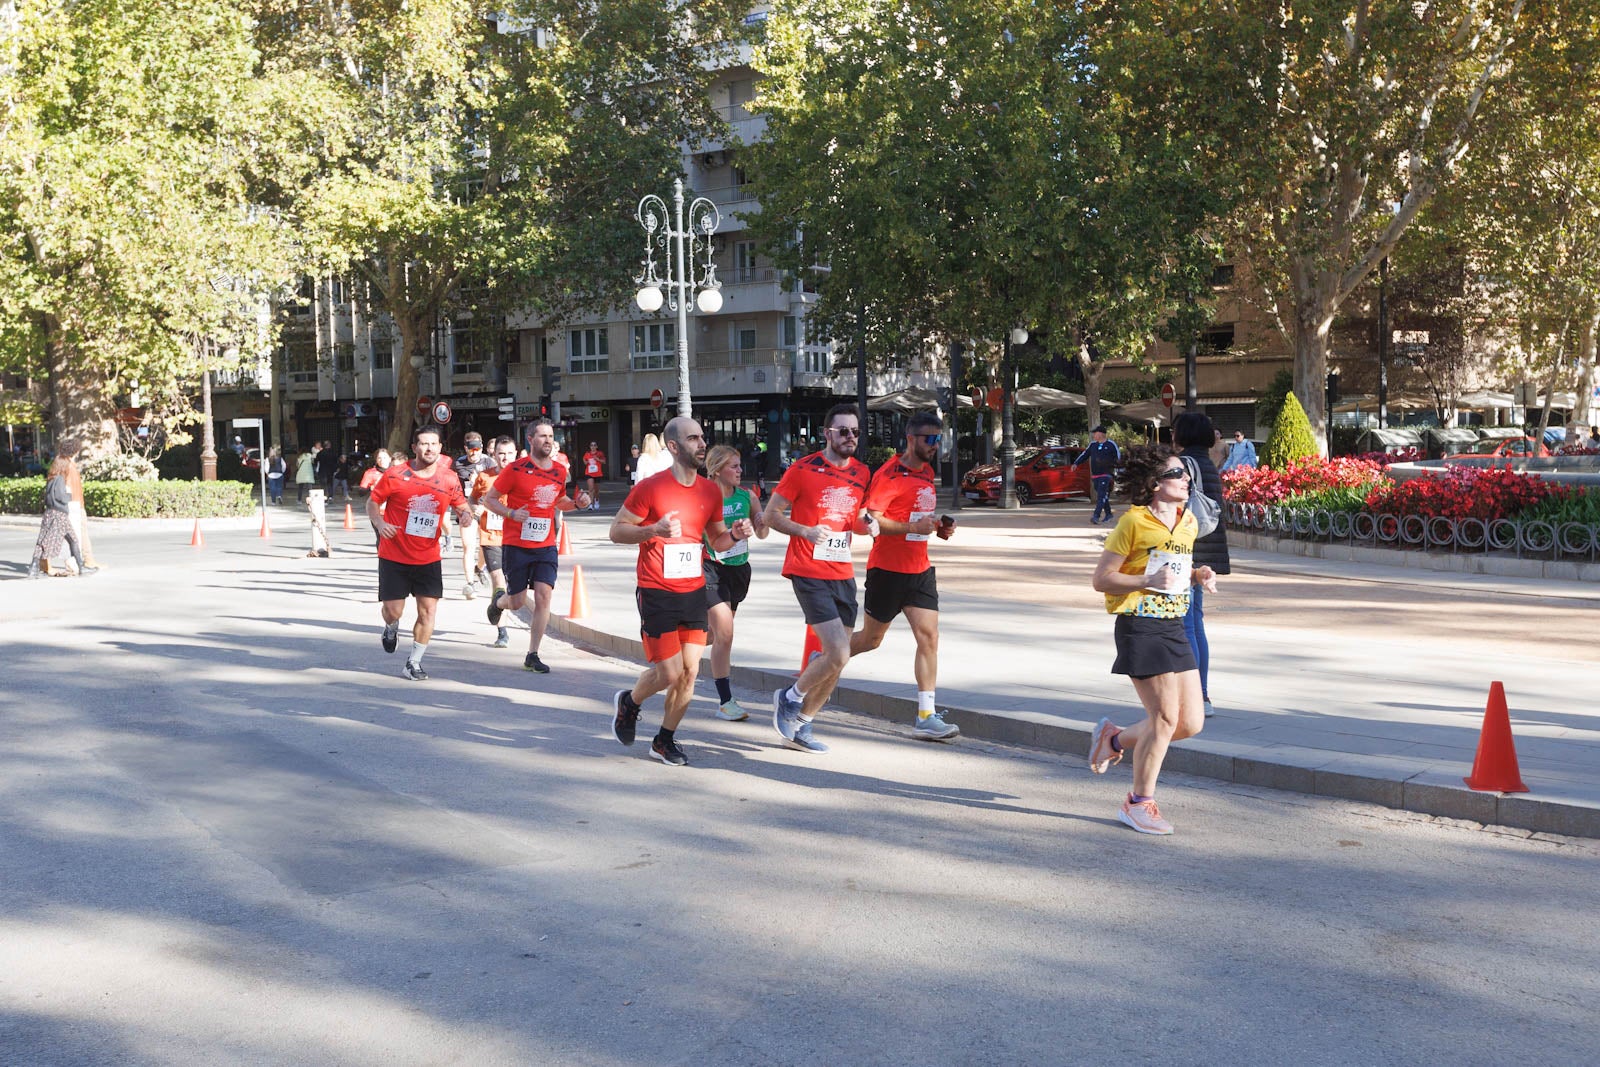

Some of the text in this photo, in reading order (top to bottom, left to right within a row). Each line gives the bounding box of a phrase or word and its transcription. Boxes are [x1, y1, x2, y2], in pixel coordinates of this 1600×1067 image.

[413, 516, 434, 527] 1189
[527, 521, 547, 531] 1035
[827, 538, 847, 549] 136
[679, 551, 692, 562] 70
